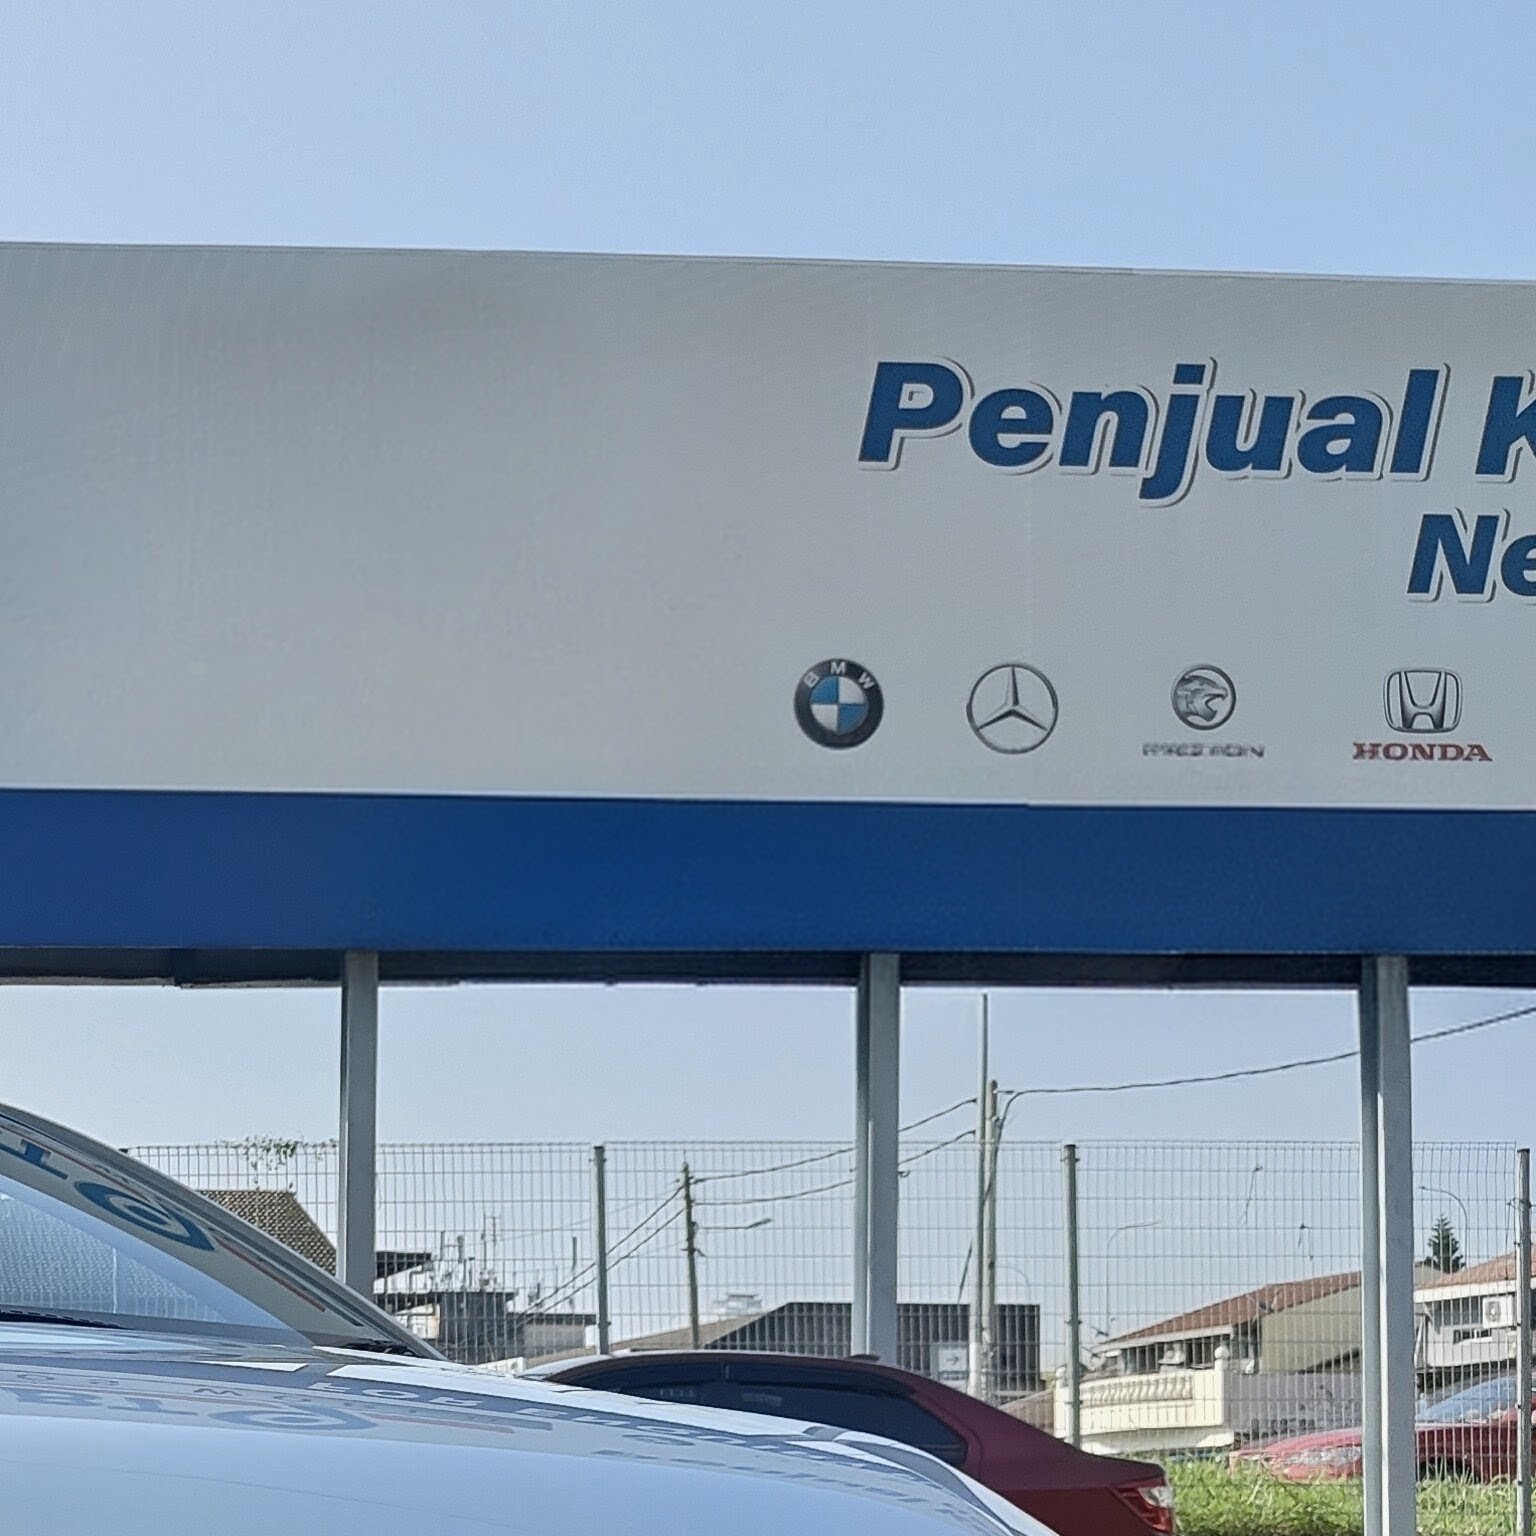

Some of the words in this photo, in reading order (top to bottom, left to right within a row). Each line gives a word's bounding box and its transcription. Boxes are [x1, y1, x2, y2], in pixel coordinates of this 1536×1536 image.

[858, 358, 1448, 503] Penjual
[803, 661, 875, 690] BMW
[1352, 742, 1493, 762] HONDA
